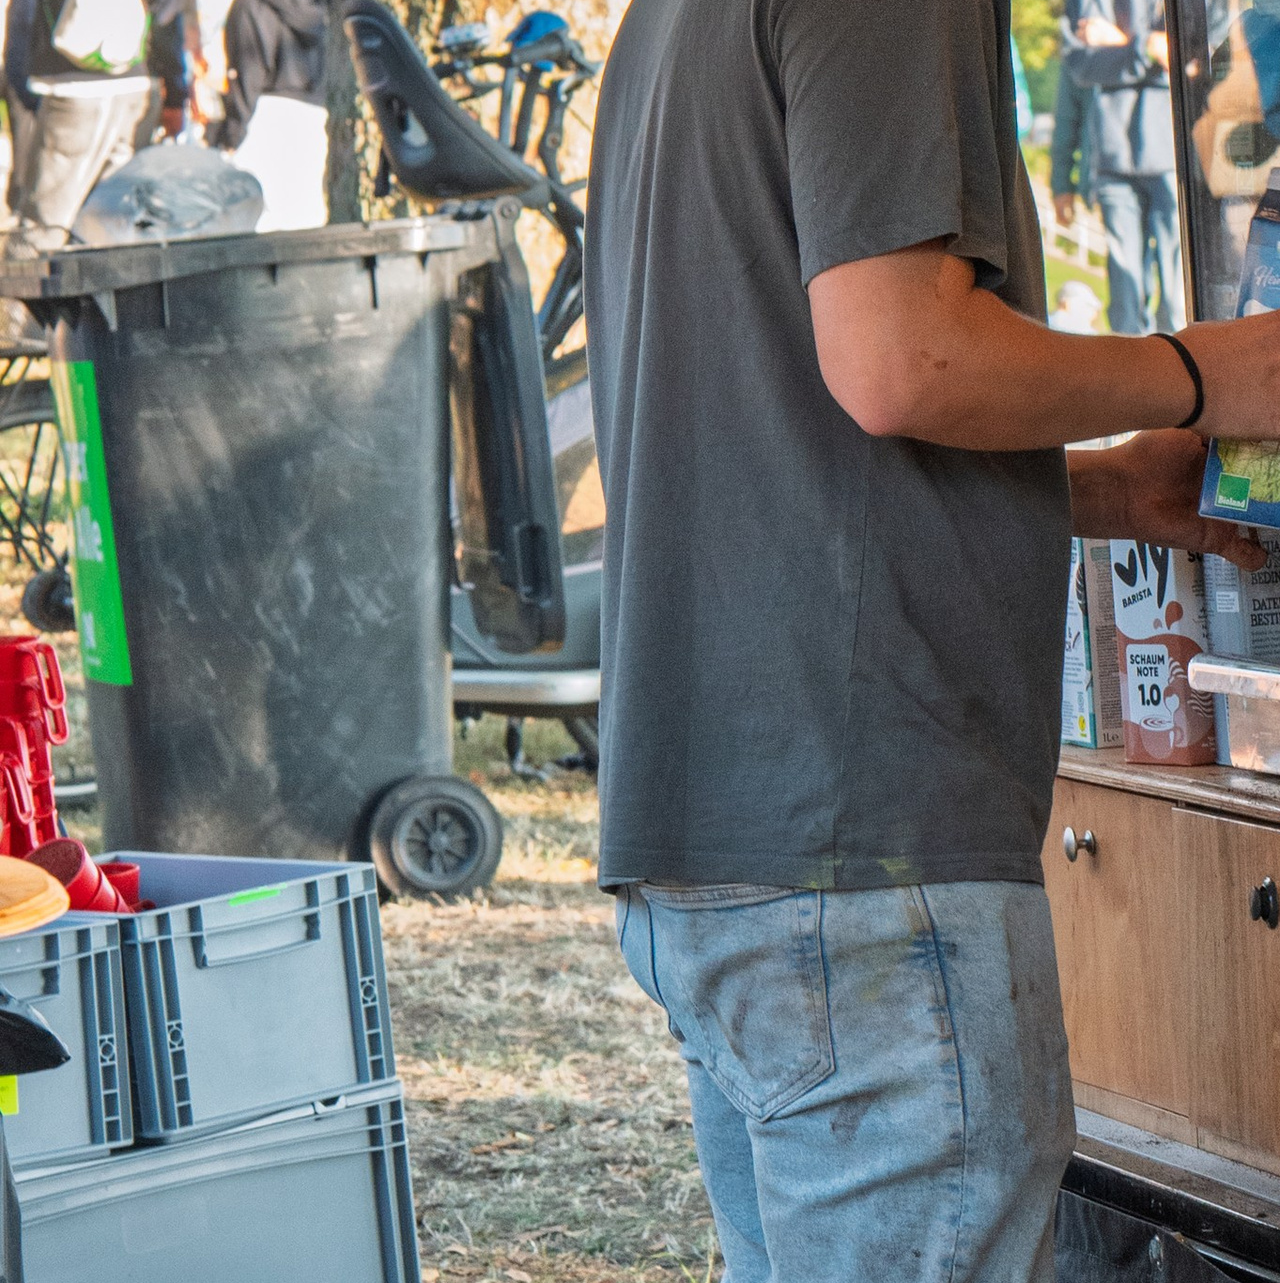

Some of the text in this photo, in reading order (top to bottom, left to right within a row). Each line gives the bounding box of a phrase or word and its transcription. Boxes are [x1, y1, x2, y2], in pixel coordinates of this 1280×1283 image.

[1217, 495, 1246, 508] Bioland
[1122, 587, 1153, 609] BARISTA
[1130, 654, 1166, 666] SCHAUM
[1136, 666, 1159, 677] NOTE
[1138, 684, 1162, 706] 1.0
